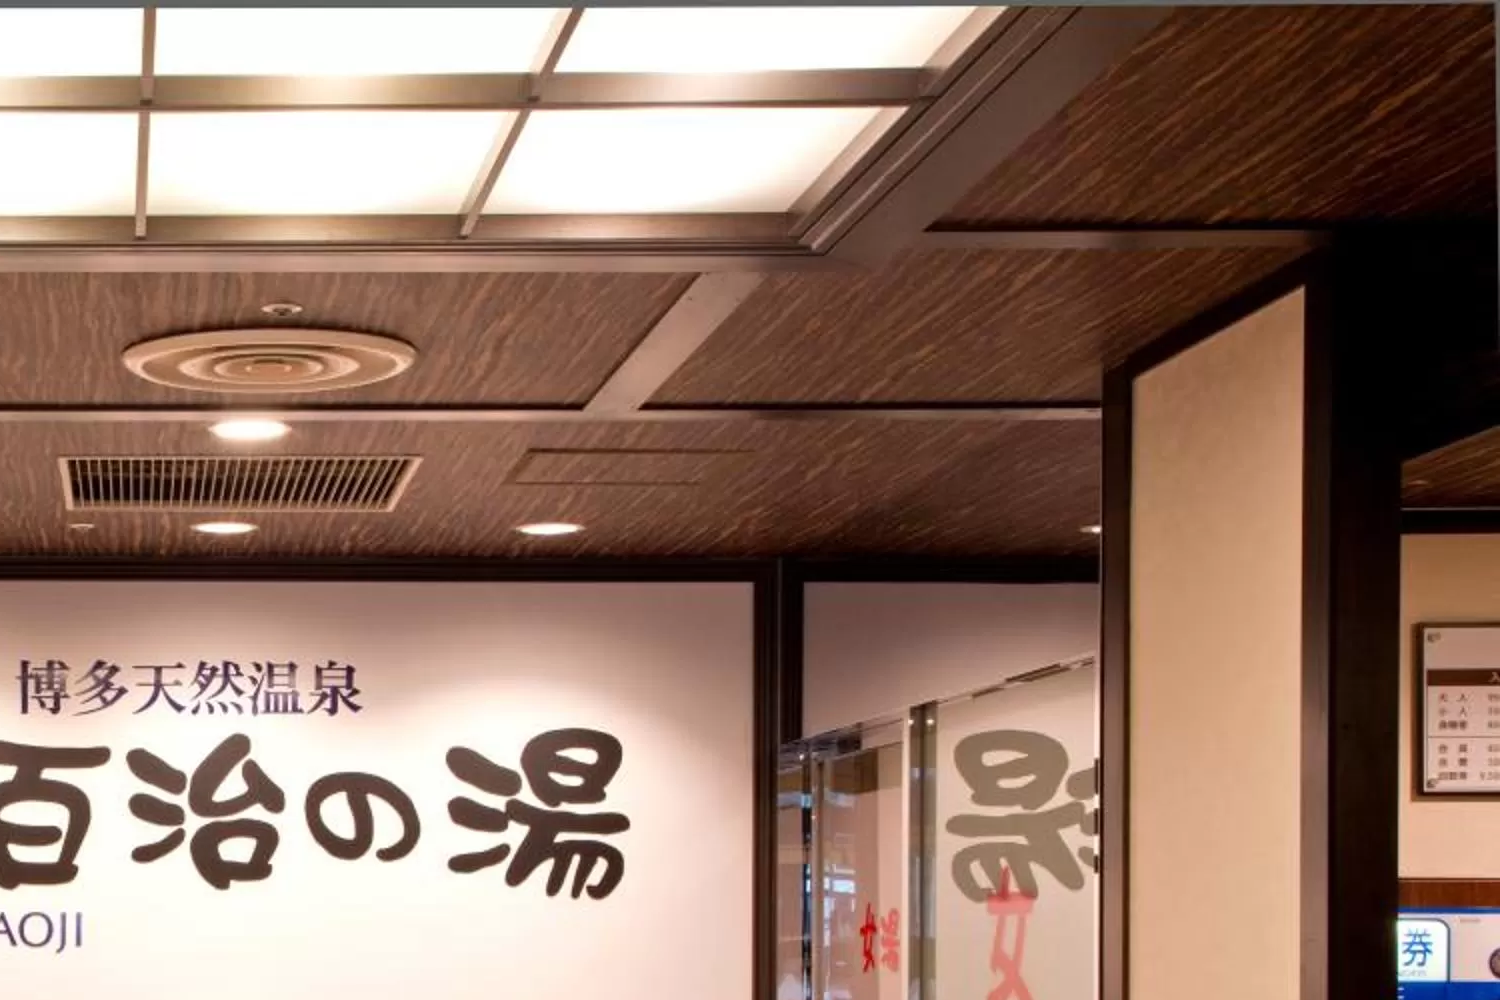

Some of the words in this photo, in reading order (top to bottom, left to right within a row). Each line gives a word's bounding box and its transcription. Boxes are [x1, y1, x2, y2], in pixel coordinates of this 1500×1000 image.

[15, 659, 364, 718] 博多天然温泉
[1402, 928, 1433, 967] 券
